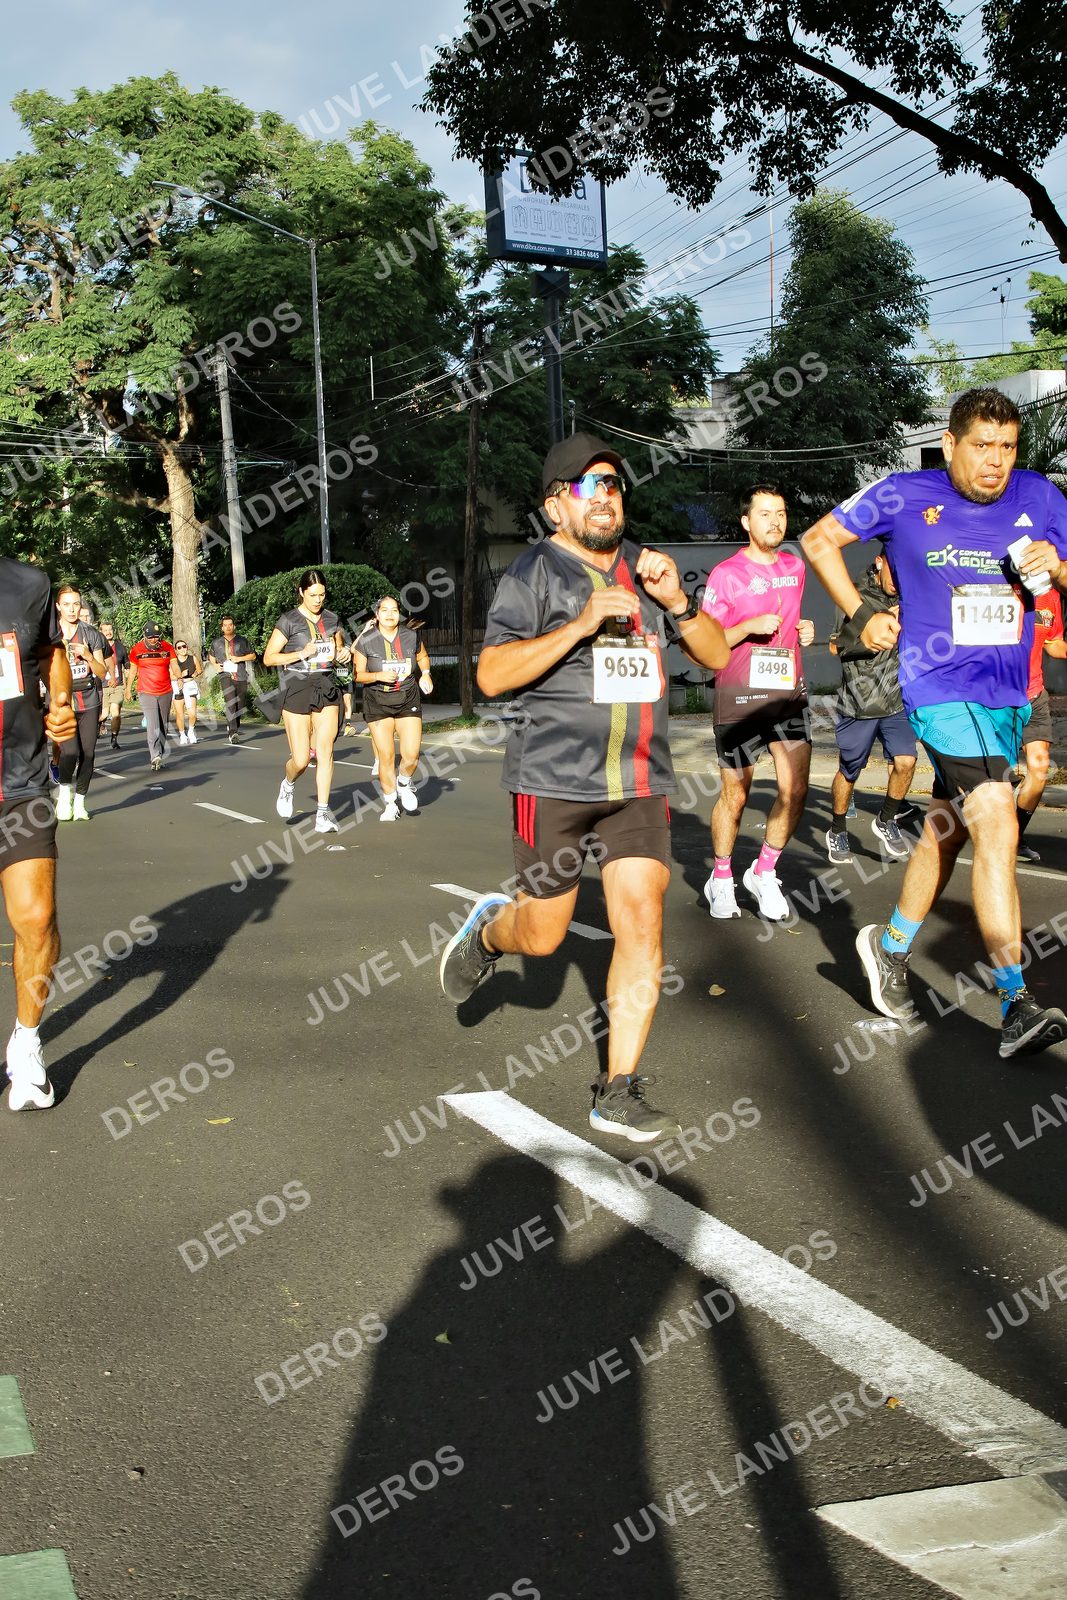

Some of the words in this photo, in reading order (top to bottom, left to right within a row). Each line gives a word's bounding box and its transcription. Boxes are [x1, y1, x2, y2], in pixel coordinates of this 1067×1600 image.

[512, 242, 555, 253] www.dibra.com.mx
[573, 249, 586, 257] 3826
[586, 251, 600, 259] 4845
[957, 604, 1015, 624] 11443
[604, 656, 650, 678] 9652
[757, 661, 788, 676] 8498
